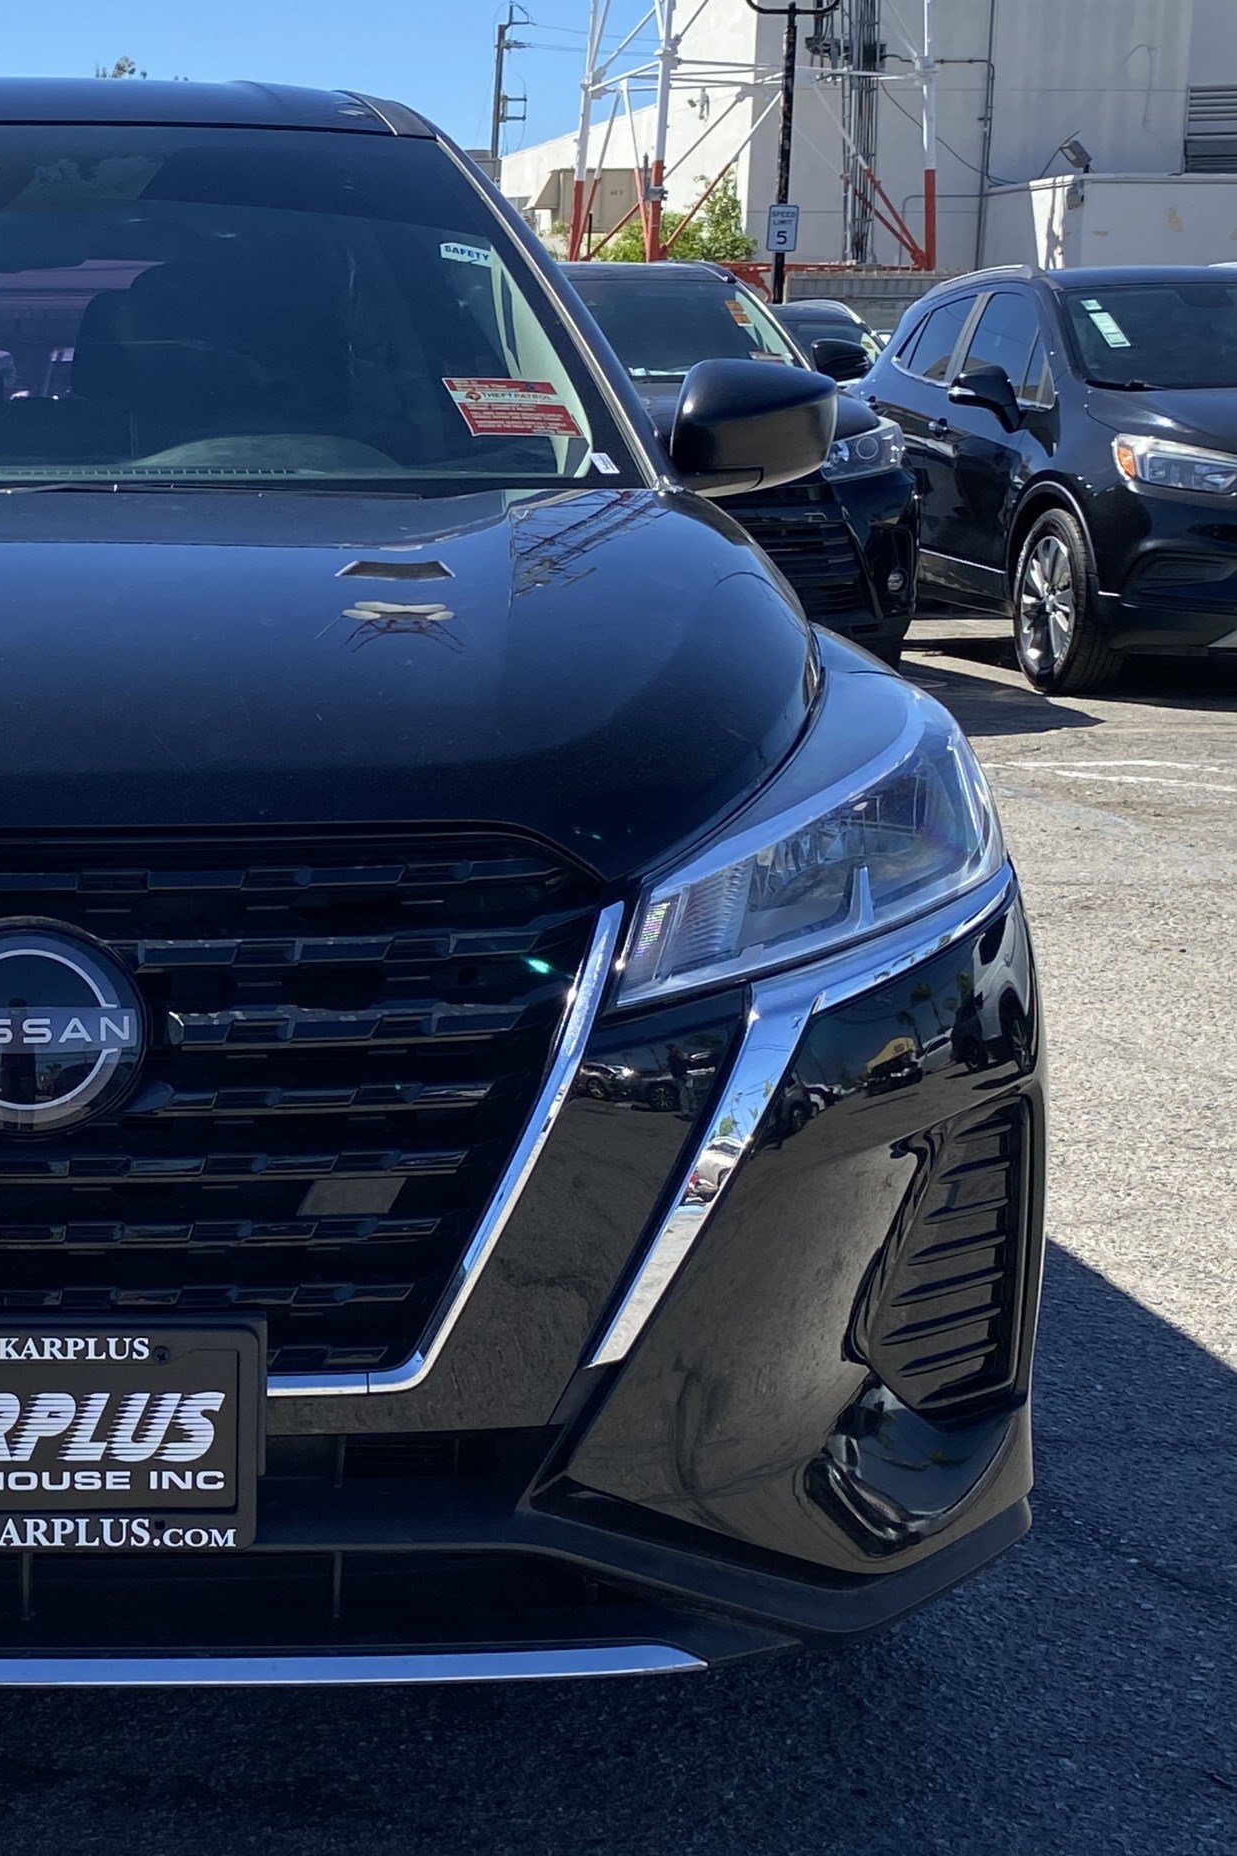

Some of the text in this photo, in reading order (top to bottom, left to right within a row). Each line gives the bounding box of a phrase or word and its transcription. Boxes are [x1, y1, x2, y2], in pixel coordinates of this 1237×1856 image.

[776, 230, 787, 245] 5
[444, 245, 489, 261] SAFETY
[149, 1471, 225, 1491] INC
